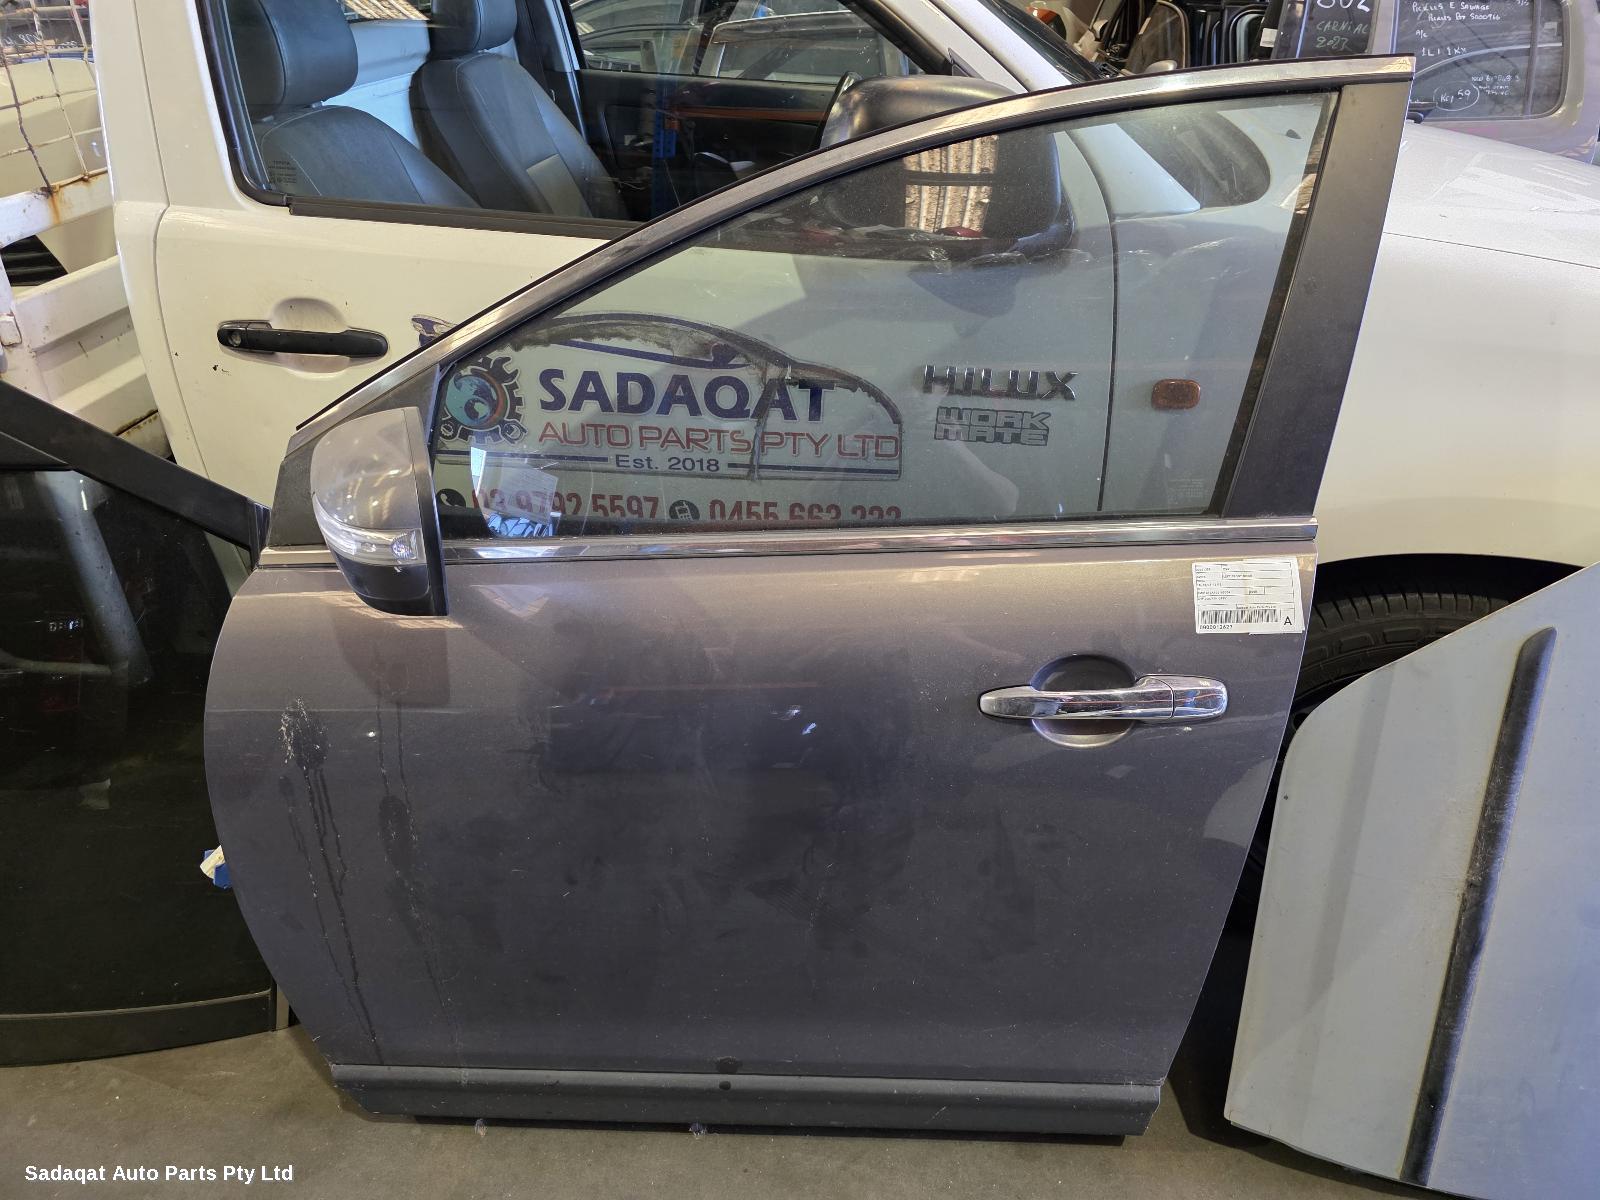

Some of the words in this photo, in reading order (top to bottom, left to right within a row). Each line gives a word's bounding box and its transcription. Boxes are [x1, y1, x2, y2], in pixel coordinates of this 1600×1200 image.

[539, 368, 835, 421] SADAQAT
[922, 365, 1079, 400] HILUX
[936, 406, 1051, 430] WORK
[538, 421, 630, 447] AUTO
[638, 425, 754, 453] PARTS
[760, 431, 829, 456] PTY
[837, 433, 900, 459] LTD
[934, 423, 1049, 446] MATE
[615, 454, 659, 470] Est.
[667, 456, 720, 472] 2018
[1283, 615, 1293, 626] A
